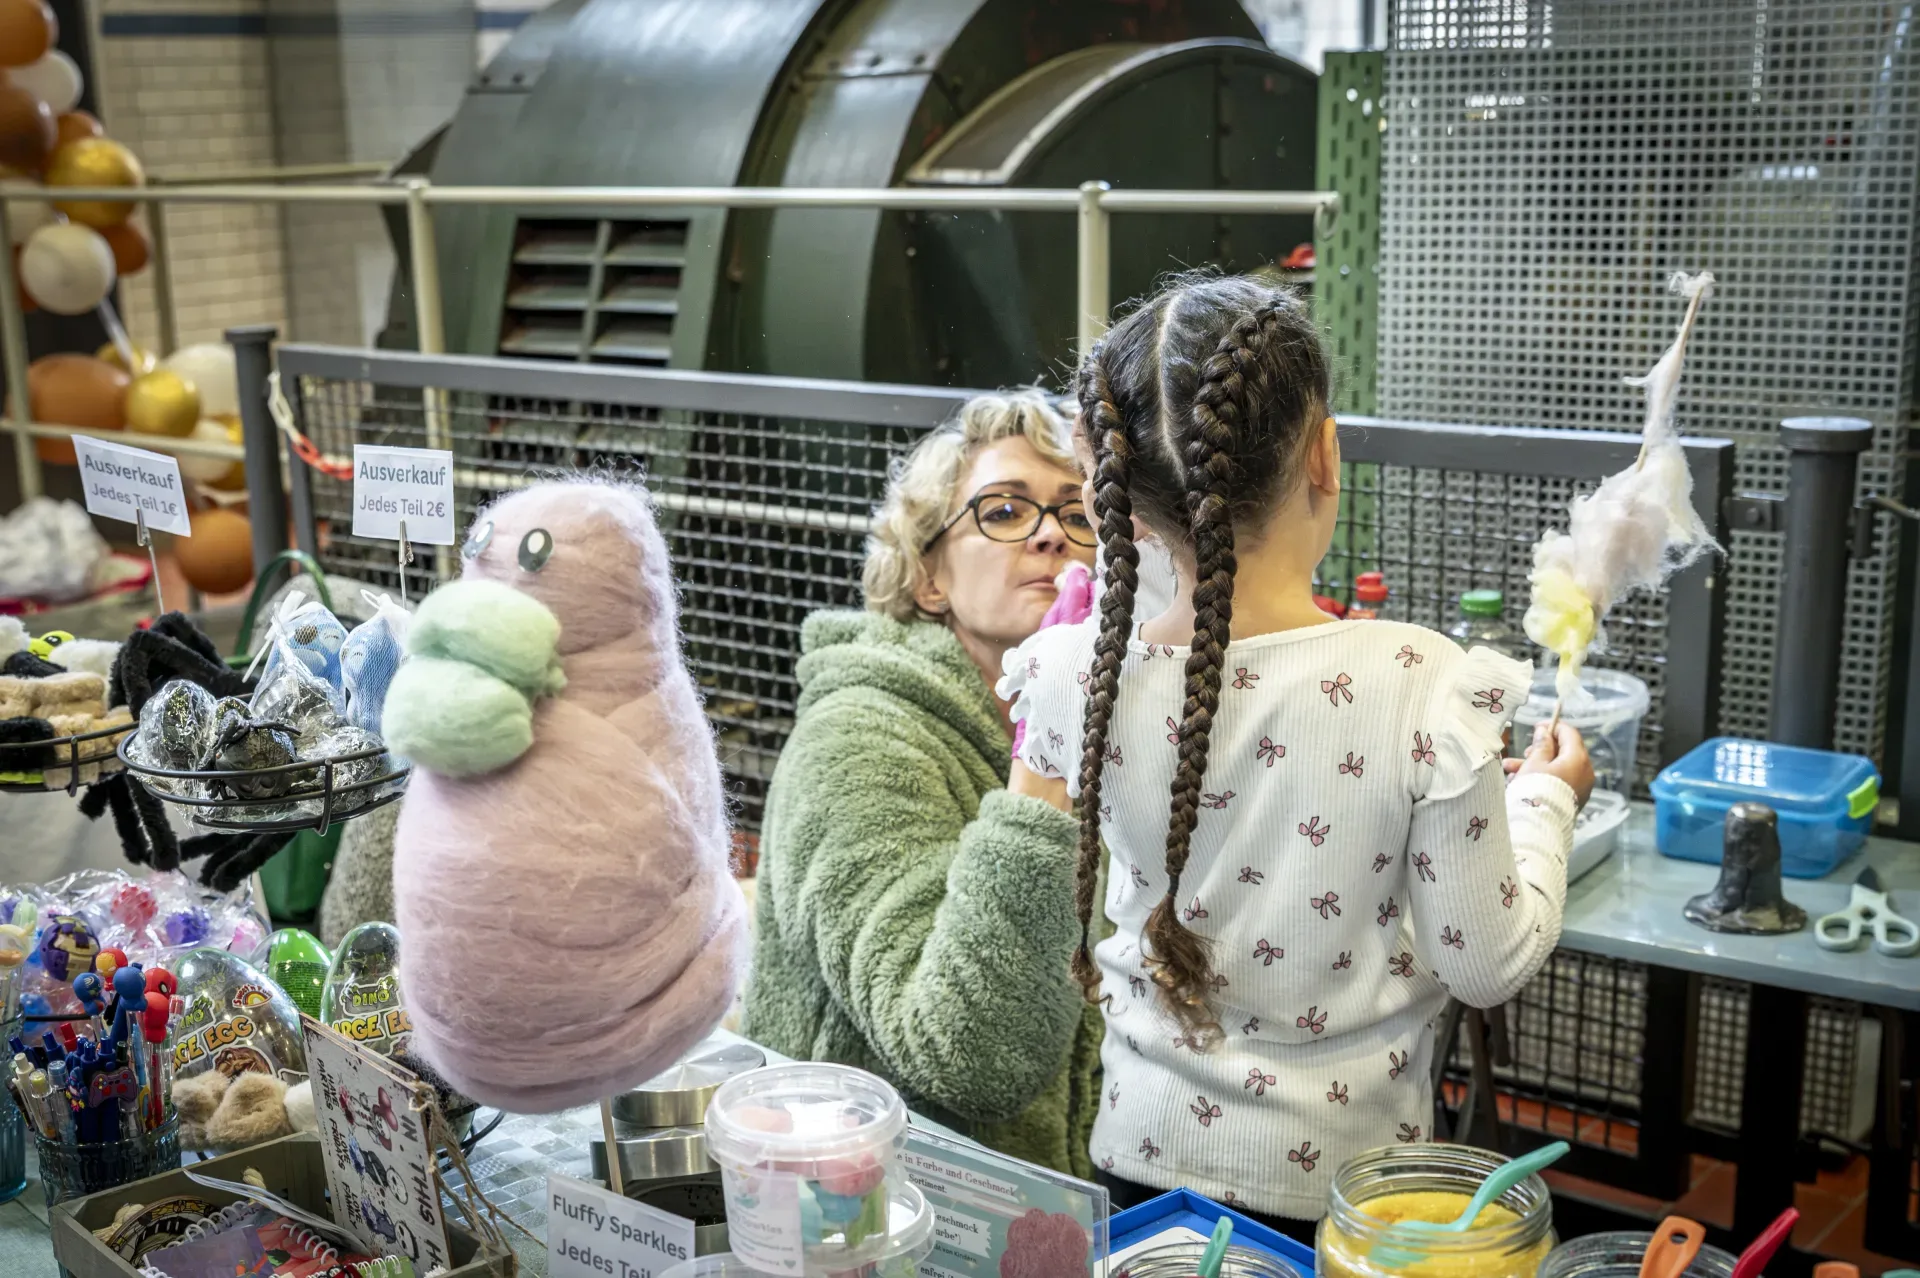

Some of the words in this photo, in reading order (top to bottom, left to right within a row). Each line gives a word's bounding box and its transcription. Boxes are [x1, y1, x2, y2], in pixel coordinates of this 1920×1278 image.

[85, 454, 174, 490] Ausverkauf
[360, 461, 446, 486] Ausverkauf
[92, 483, 131, 504] Jedes
[133, 493, 159, 512] Teil
[160, 501, 179, 516] 1€
[360, 495, 397, 513] Jedes
[401, 498, 423, 516] Teil
[427, 501, 445, 518] 2€
[352, 988, 390, 1007] DINO
[181, 1009, 204, 1029] INO
[203, 1016, 254, 1051] EGG
[333, 1015, 384, 1042] ARGE
[386, 1010, 414, 1036] EG
[316, 1057, 334, 1111] PARTIES
[327, 1073, 339, 1108] HAVE
[329, 1117, 346, 1171] FRIDAYS
[401, 1114, 418, 1142] IN
[339, 1132, 351, 1165] LOVE
[905, 1153, 914, 1165] in
[916, 1156, 942, 1173] Farbe
[945, 1169, 962, 1180] und
[965, 1173, 1015, 1197] Geschmack
[341, 1181, 358, 1230] FAMILY
[351, 1192, 363, 1224] LOVE
[408, 1162, 435, 1226] THIS
[553, 1194, 605, 1232] Fluffy
[610, 1215, 687, 1261] Sparkles
[935, 1212, 979, 1234] eschmack
[557, 1238, 613, 1275] Jedes
[920, 1266, 945, 1278] enfrei
